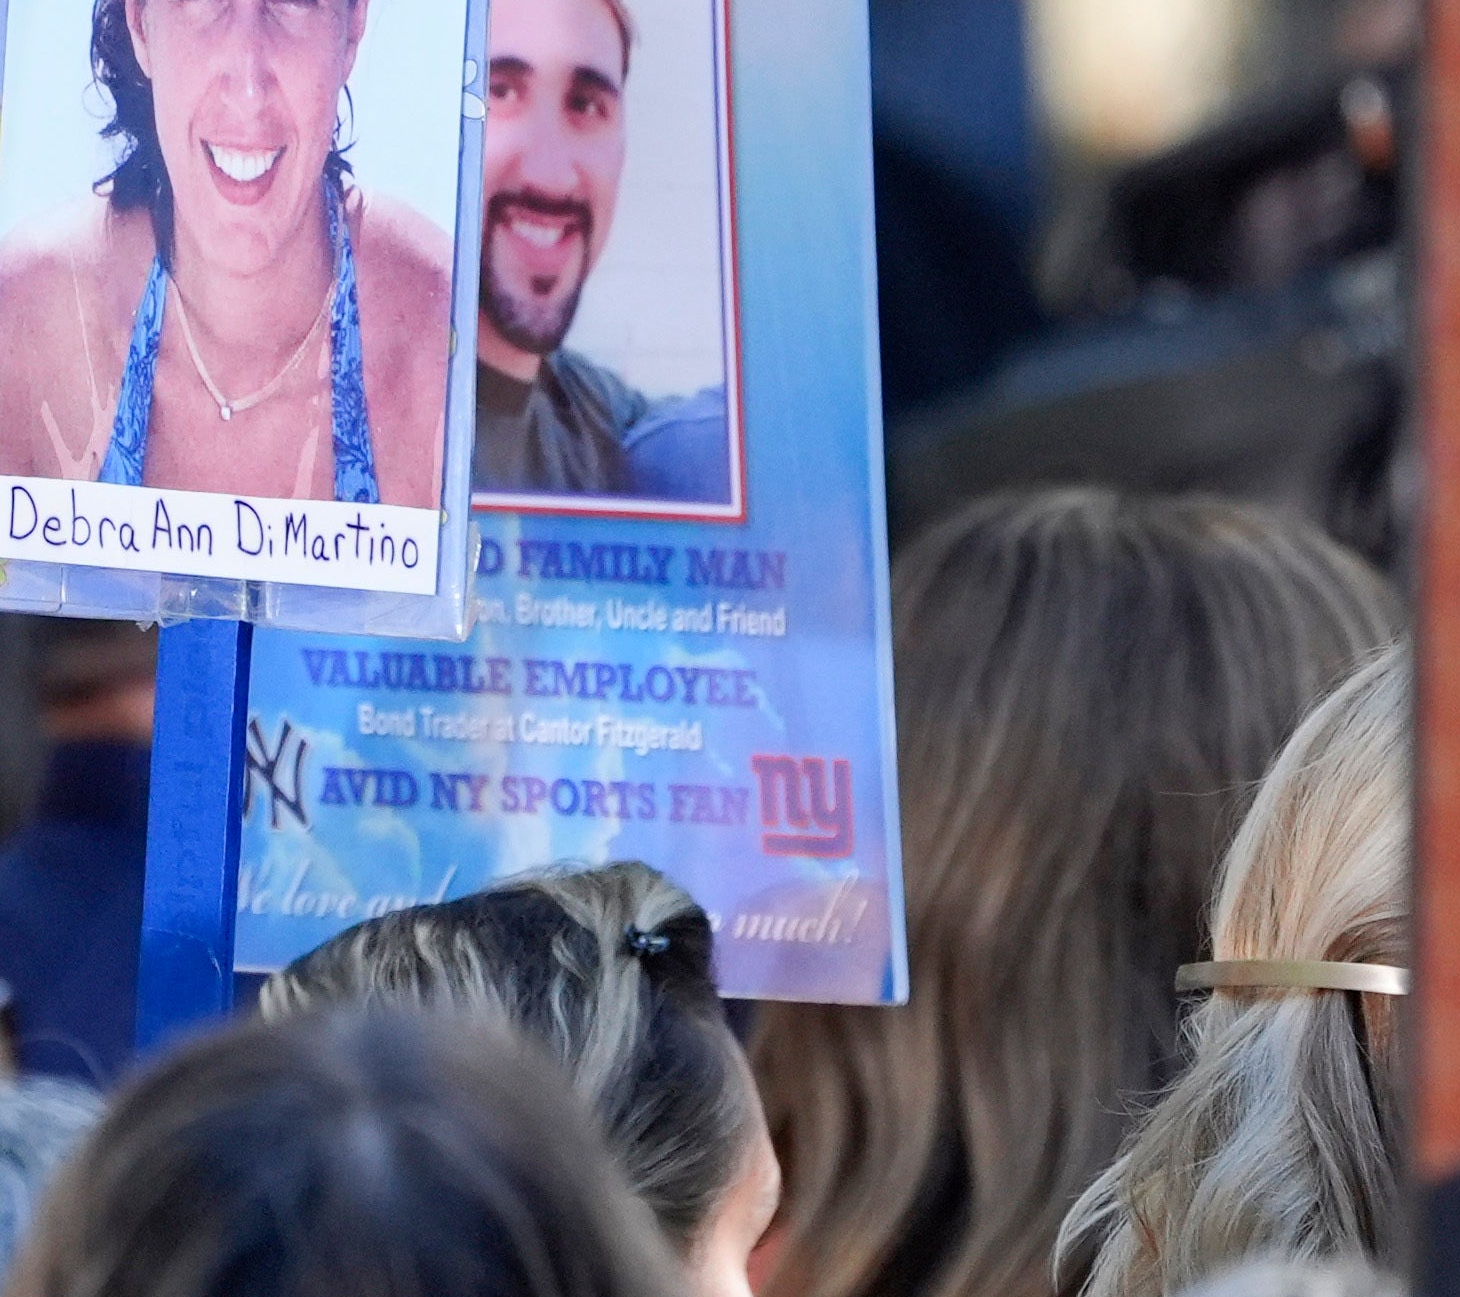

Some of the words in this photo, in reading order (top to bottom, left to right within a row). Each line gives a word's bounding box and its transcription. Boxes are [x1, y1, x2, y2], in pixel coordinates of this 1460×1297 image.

[8, 485, 140, 552] Debra
[151, 498, 213, 556] Ann
[516, 540, 676, 586] FAMILY
[685, 547, 787, 591] MAN
[515, 593, 602, 632] Brother,
[605, 597, 670, 632] Uncle
[671, 600, 714, 634] and
[716, 602, 788, 637] Friend
[302, 648, 513, 695] VALUABLE
[522, 659, 758, 708] EMPLOYEE
[357, 701, 416, 739] Bond
[418, 705, 492, 743] Trader
[495, 714, 515, 743] at
[519, 712, 594, 746] Cantor
[597, 716, 705, 758] Fitzgerald
[319, 766, 420, 808] AVID
[430, 771, 488, 813] NY
[501, 775, 657, 821] SPORTS
[667, 782, 751, 827] FAN
[281, 858, 358, 919] love
[733, 867, 868, 944] much!
